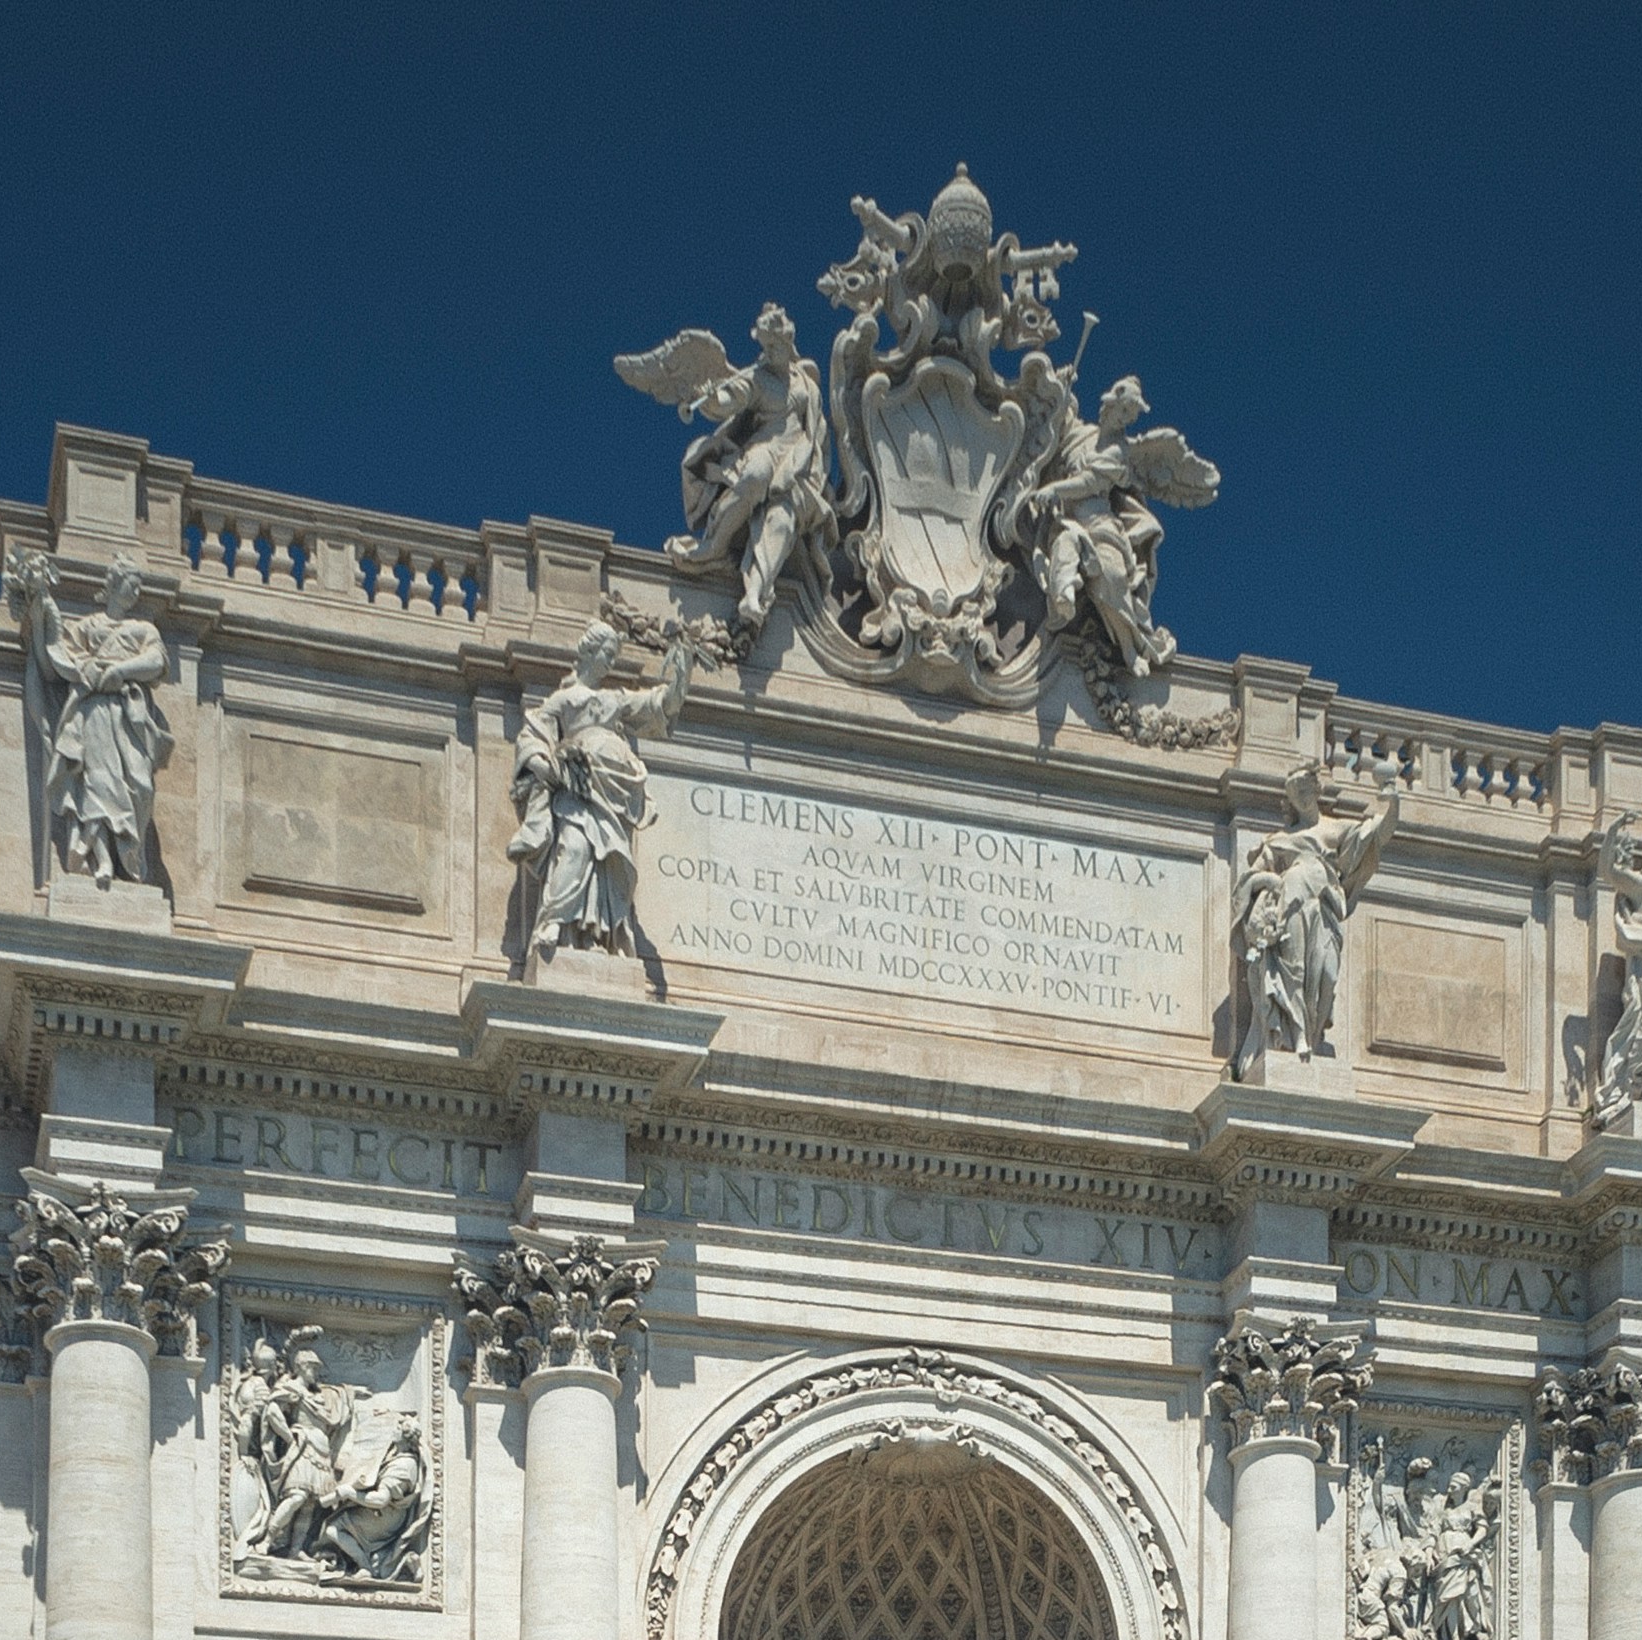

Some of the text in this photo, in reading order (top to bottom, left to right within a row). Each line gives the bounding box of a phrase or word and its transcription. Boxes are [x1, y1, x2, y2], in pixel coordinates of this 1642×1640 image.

[690, 786, 854, 839] CLEMENS
[658, 854, 1184, 955] COPIA ET SALVBRITATE COMMENDATAM
[801, 845, 1054, 904] AQVAM VIRGINEM
[670, 923, 753, 955] ANNO
[763, 935, 864, 971] DOMINI
[729, 899, 1123, 977] CVLTV MAGNIFICO ORNAVIT
[172, 1106, 503, 1195] PERFECIT
[638, 1160, 1045, 1256] BENEDICTVS
